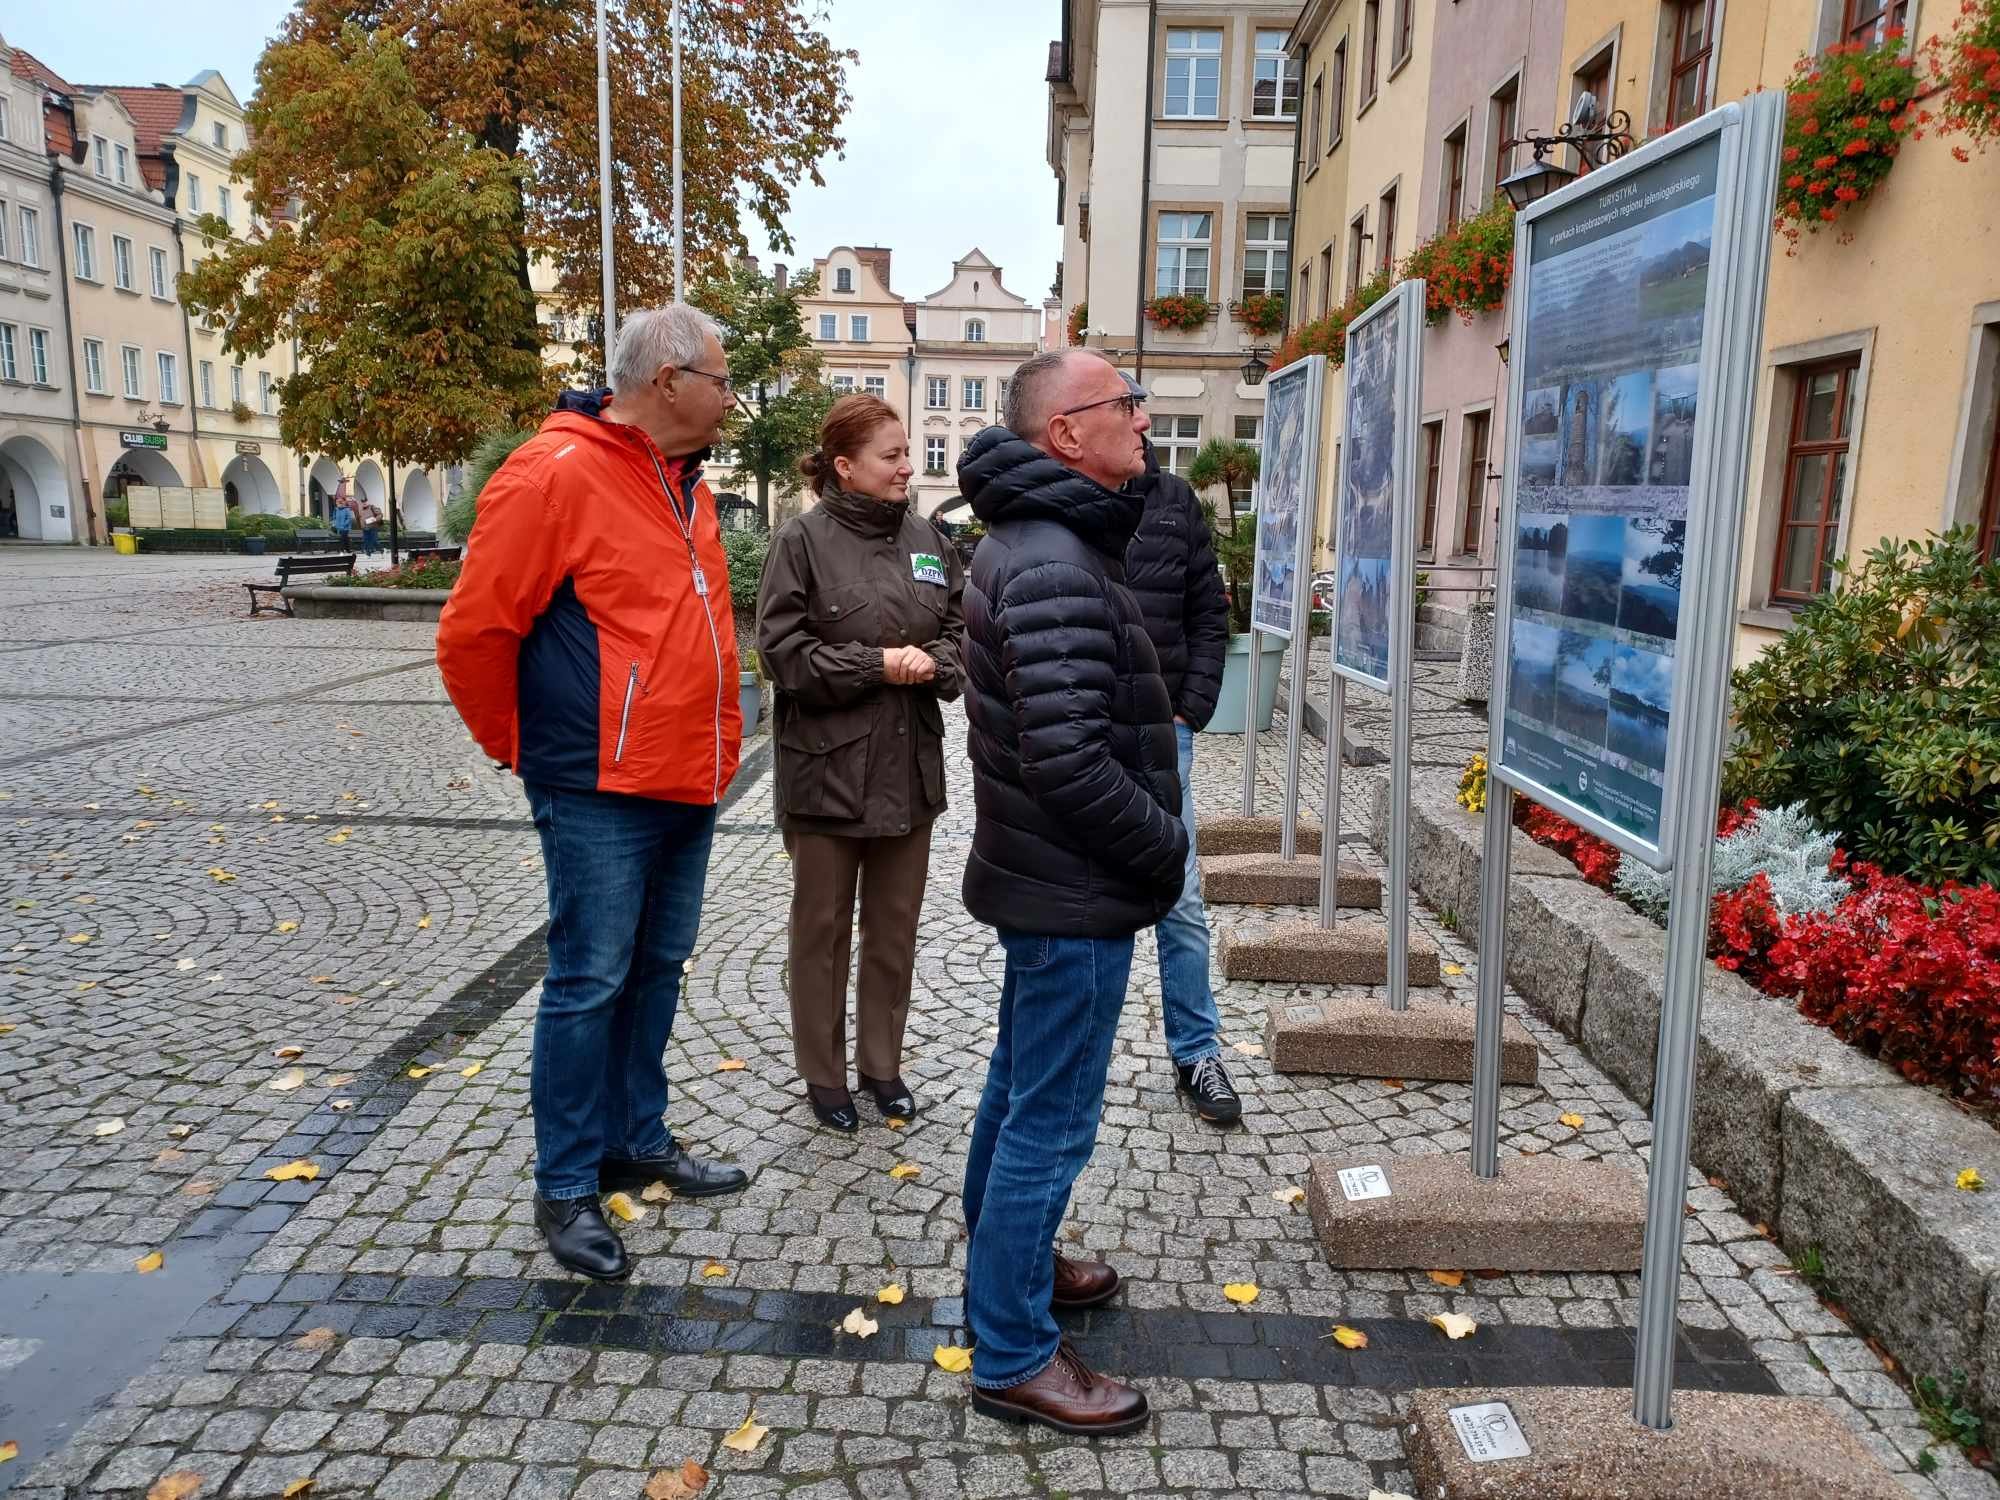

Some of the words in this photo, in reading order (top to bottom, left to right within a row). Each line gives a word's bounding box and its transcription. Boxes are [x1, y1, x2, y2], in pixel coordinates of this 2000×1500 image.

[1599, 182, 1638, 209] TURYSTYKA
[1619, 199, 1643, 217] regionu
[123, 433, 144, 443] CLUB
